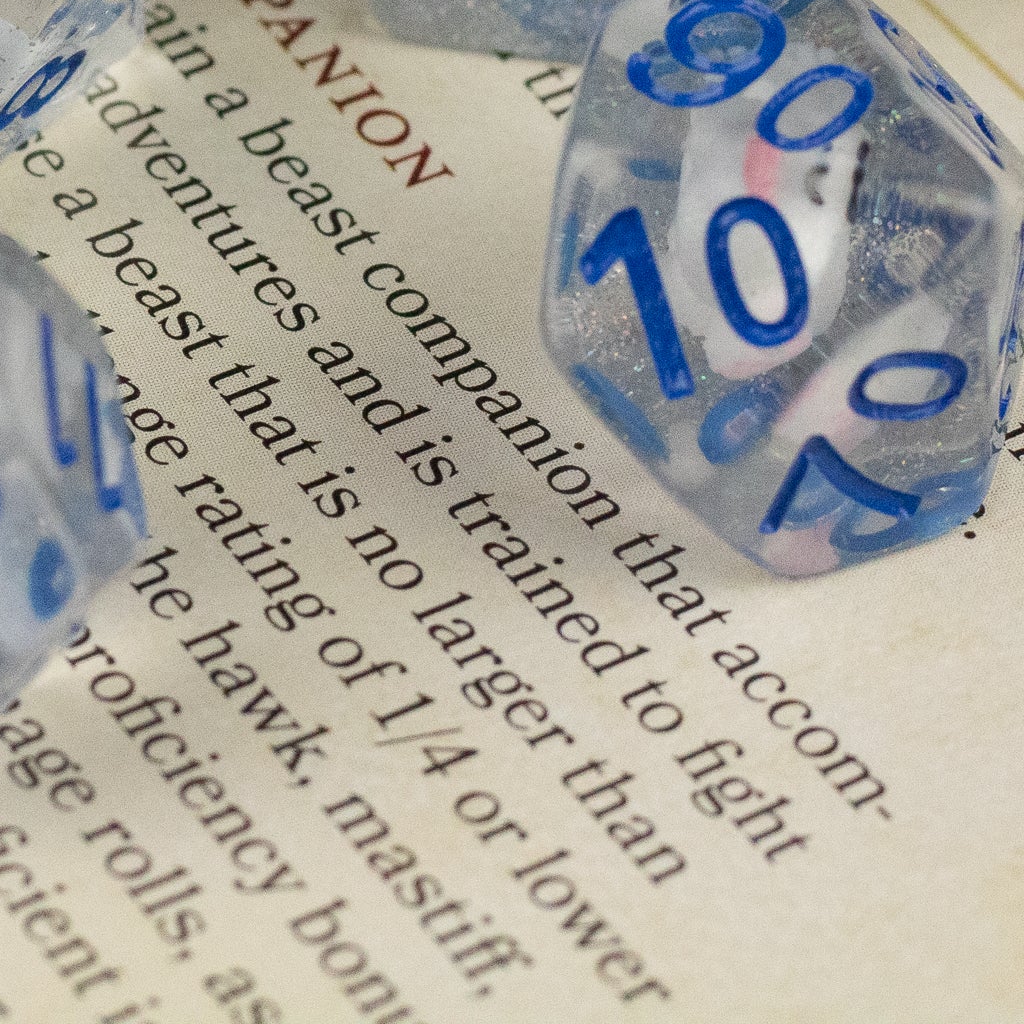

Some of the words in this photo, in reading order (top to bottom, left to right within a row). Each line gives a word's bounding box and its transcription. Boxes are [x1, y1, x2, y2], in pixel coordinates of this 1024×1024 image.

[52, 187, 99, 221] a
[85, 217, 230, 360] beast
[208, 362, 322, 466] that
[298, 465, 362, 519] is
[345, 525, 425, 591] no
[413, 591, 576, 750] larger
[562, 756, 690, 888] than
[83, 69, 321, 333] adventures
[306, 340, 432, 436] and
[394, 434, 459, 488] is
[448, 490, 650, 676] trained
[620, 677, 686, 735] to
[674, 737, 811, 864] fight
[204, 86, 250, 120] a
[238, 117, 380, 256] beast
[362, 262, 623, 531] companion
[610, 530, 733, 638] that
[711, 641, 894, 822] accom-
[578, 195, 811, 401] 10
[81, 817, 207, 964] rolls,
[175, 473, 337, 633] rating
[317, 635, 409, 689] of
[370, 692, 479, 777] 1/4
[452, 790, 528, 846] or
[511, 847, 675, 1006] lower
[180, 619, 331, 789] hawk,
[321, 791, 536, 1003] mastiff,
